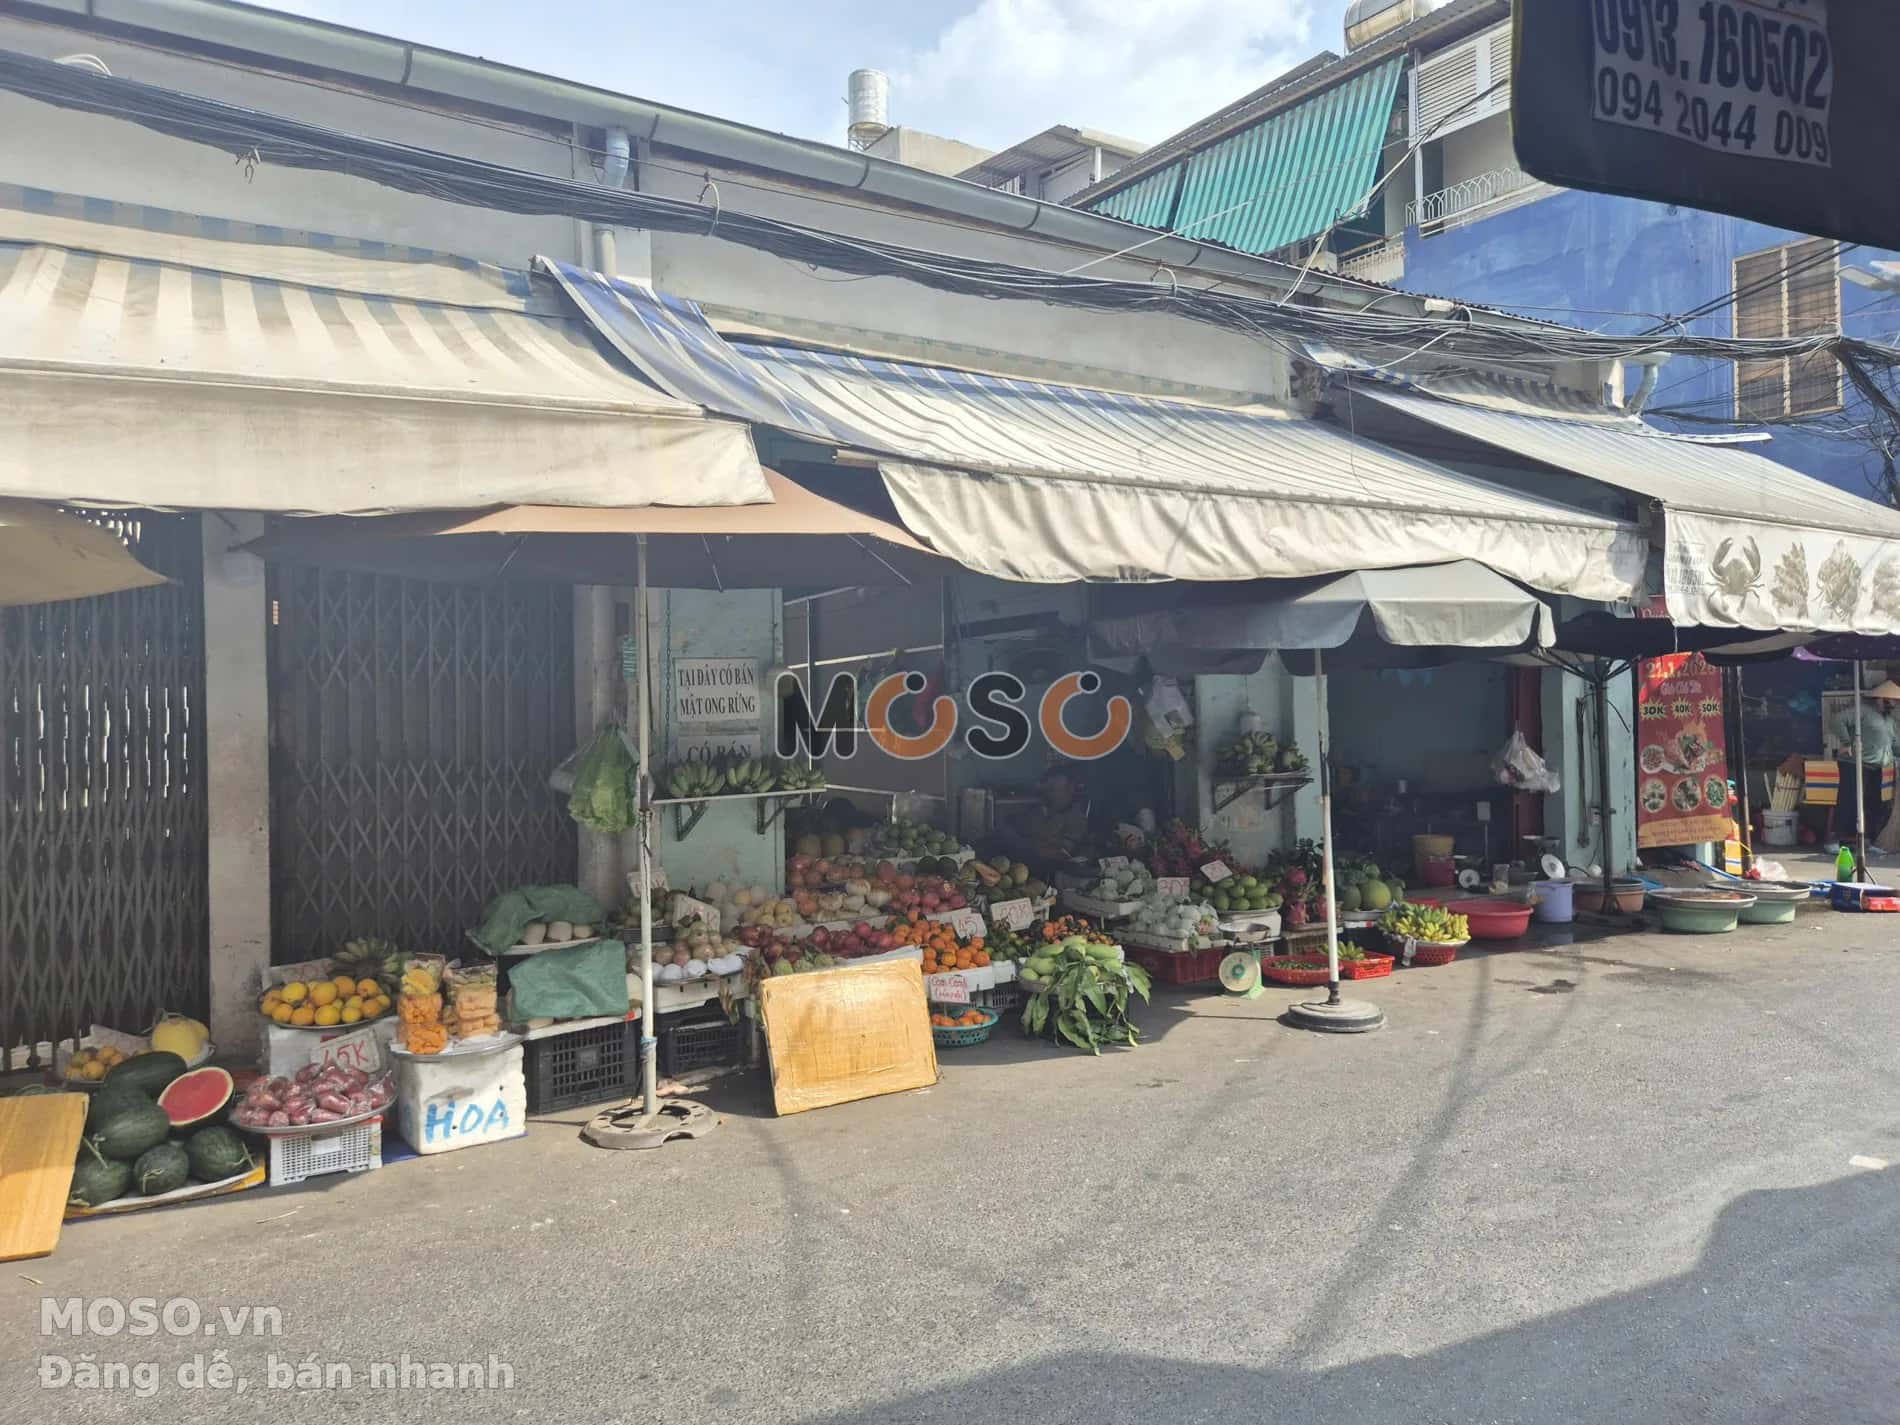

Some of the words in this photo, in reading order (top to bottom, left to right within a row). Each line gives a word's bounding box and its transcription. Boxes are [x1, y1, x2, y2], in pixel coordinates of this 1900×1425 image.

[1598, 66, 1663, 126] 094
[1675, 90, 1757, 150] 2044
[1774, 109, 1828, 163] 009
[678, 667, 696, 690] TẠI
[719, 663, 733, 686] CÓ
[734, 662, 754, 685] BÁN
[680, 693, 703, 719] MẬT
[705, 696, 725, 714] ONG
[728, 691, 756, 714] RỪNG
